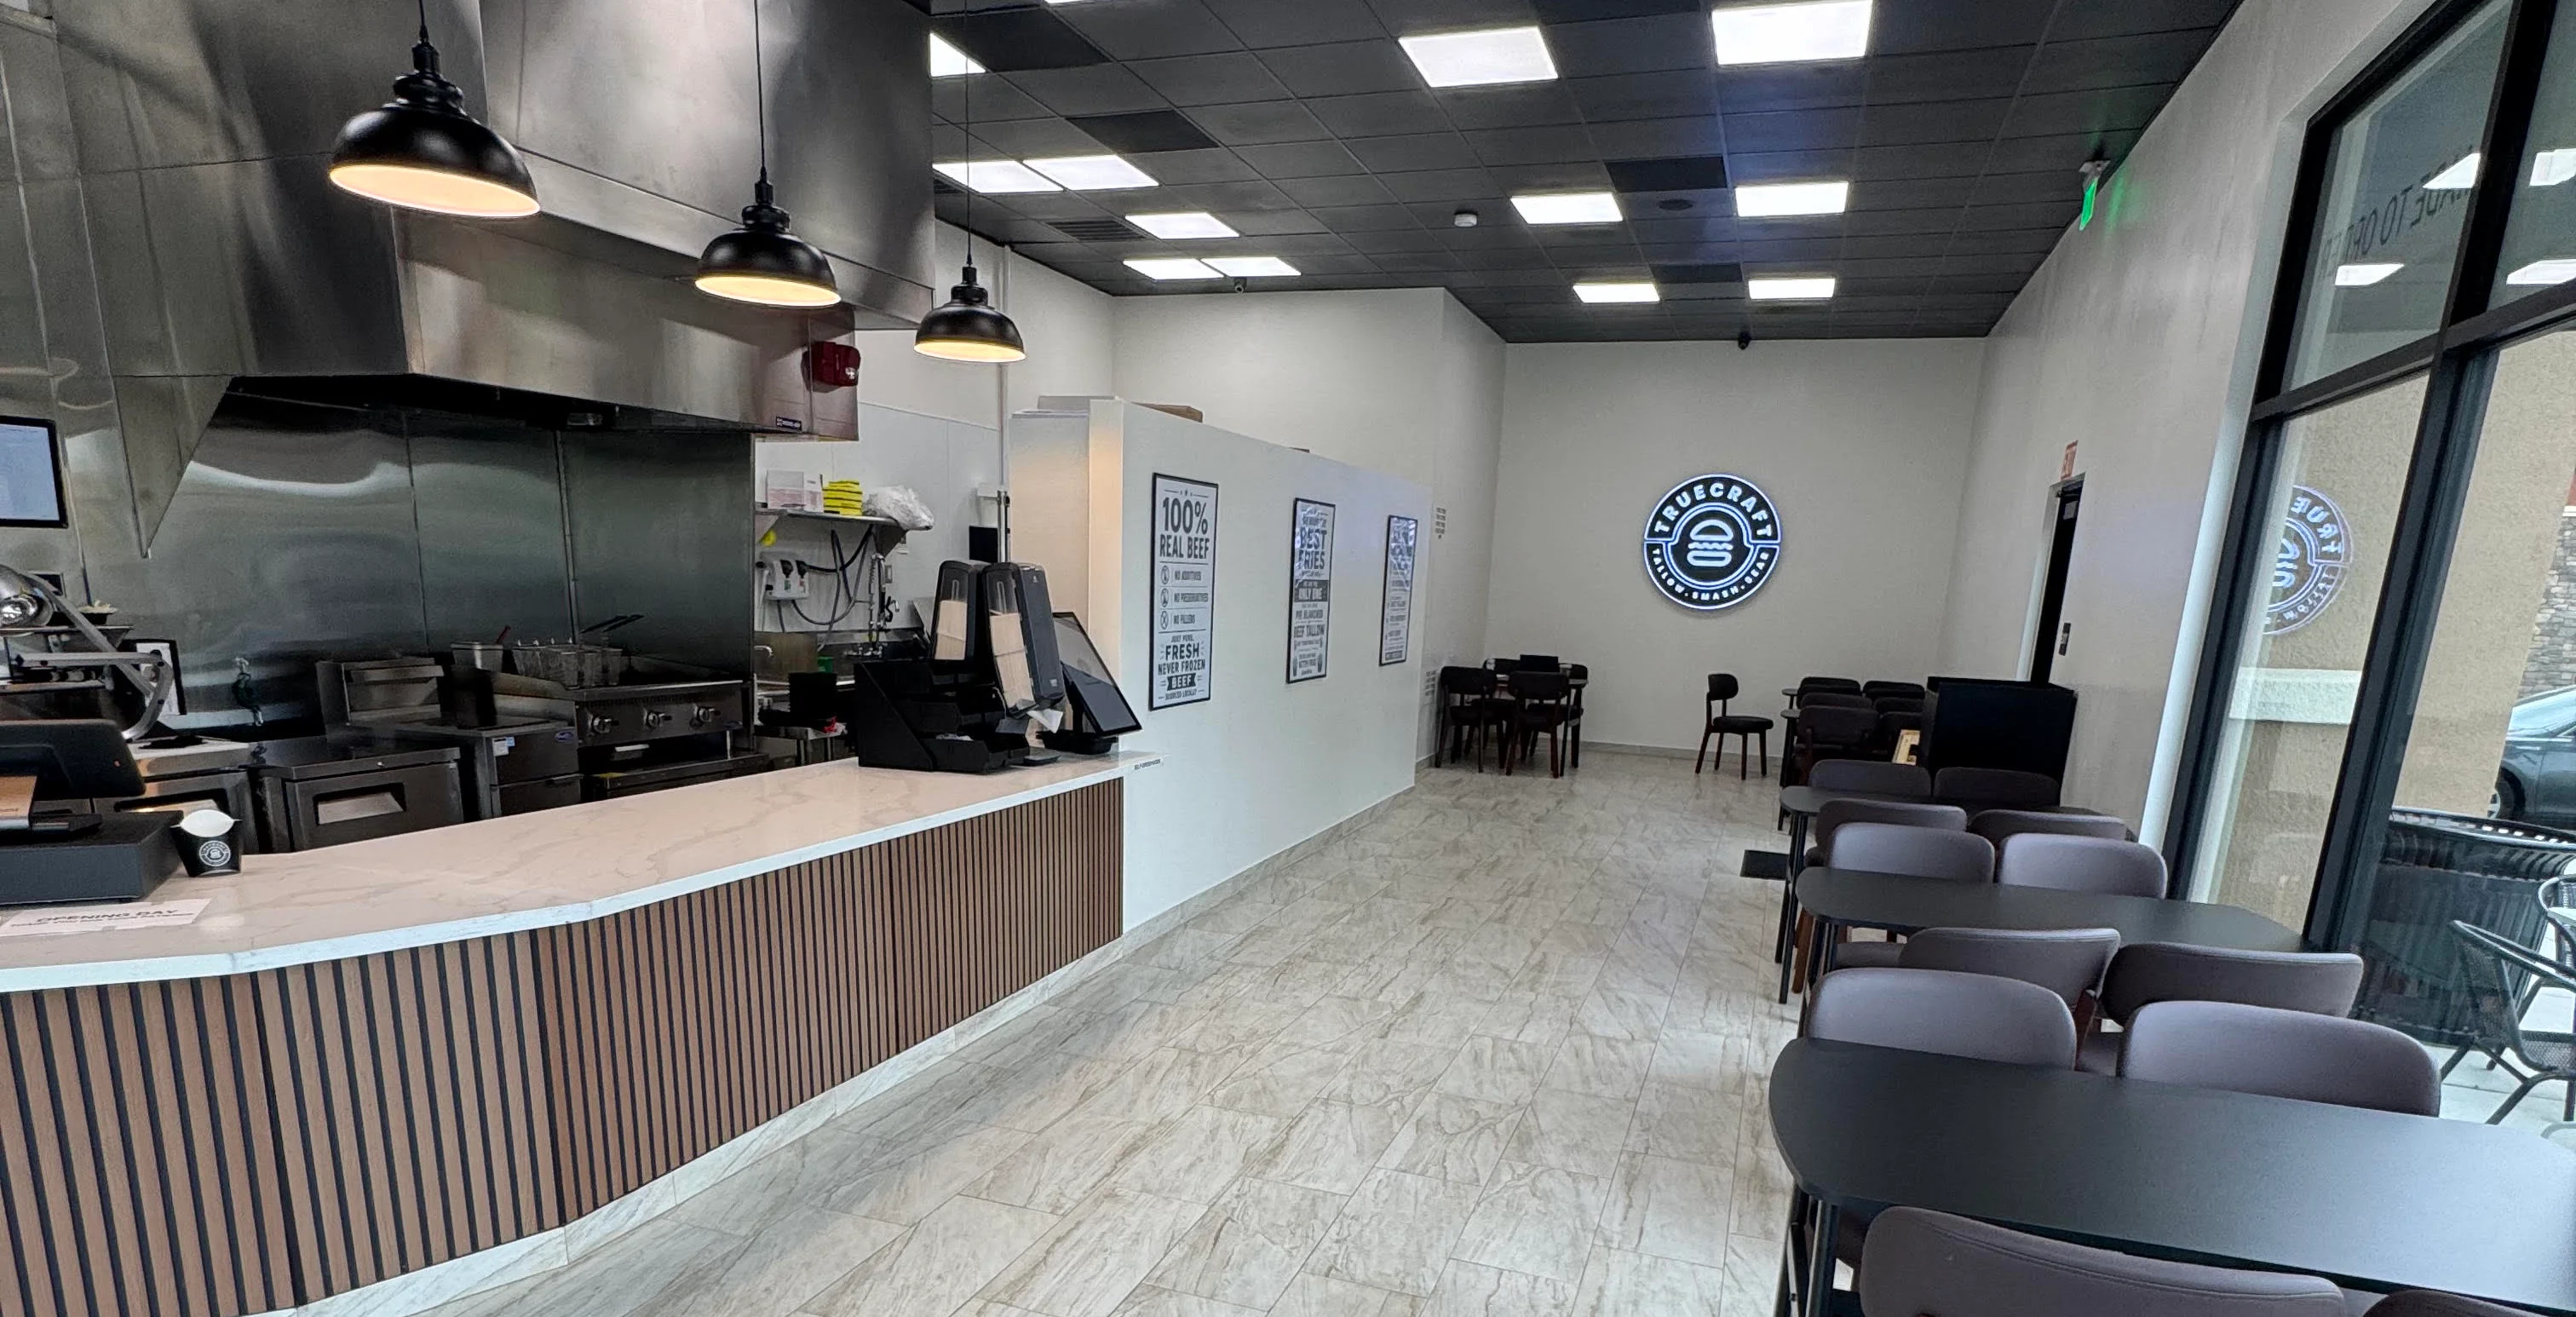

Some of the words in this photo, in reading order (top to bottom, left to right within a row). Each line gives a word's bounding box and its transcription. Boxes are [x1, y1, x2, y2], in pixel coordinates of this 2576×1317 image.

[1163, 497, 1209, 535] 100%
[1654, 482, 1773, 537] TRUECRAFT
[1159, 533, 1184, 558] REAL
[1187, 536, 1210, 560] BEEF
[1300, 526, 1327, 550] BEST
[1298, 549, 1325, 570] FRIES
[1165, 641, 1200, 661] FRESH
[1159, 661, 1180, 676] NEVER
[1182, 658, 1206, 673] FROZEN
[1171, 675, 1192, 689] BEEF
